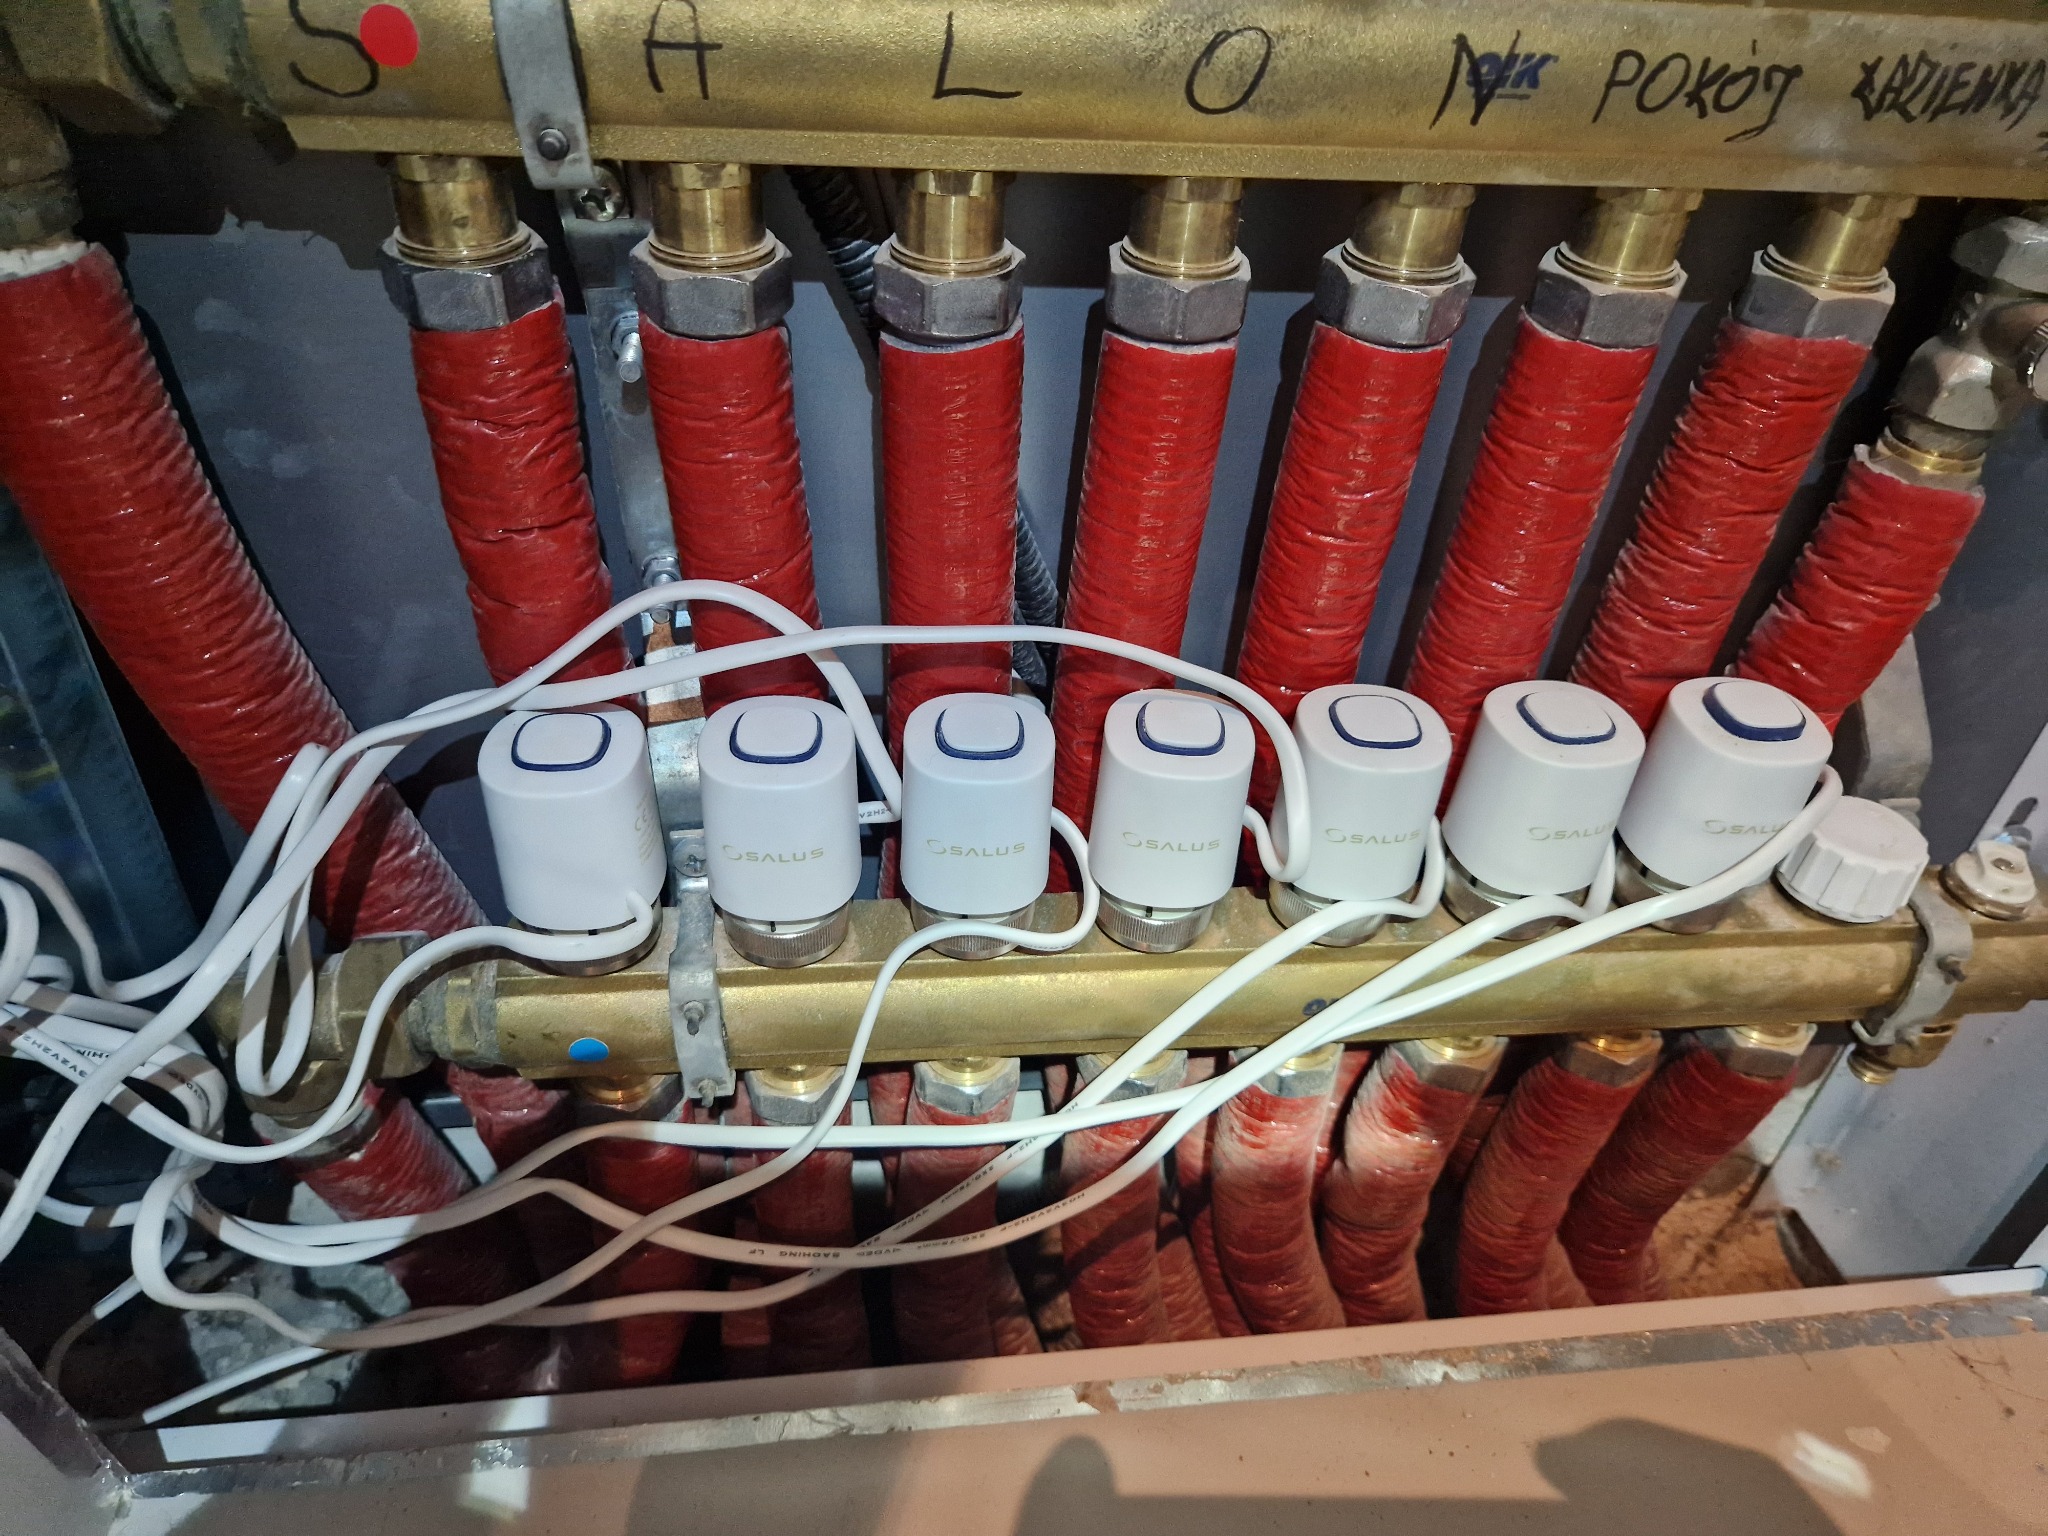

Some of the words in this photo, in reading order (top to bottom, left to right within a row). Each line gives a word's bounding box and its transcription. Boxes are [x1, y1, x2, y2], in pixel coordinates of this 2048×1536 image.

[1729, 821, 1784, 835] SALU
[1350, 829, 1421, 845] SALUS
[949, 842, 1025, 857] SALUS
[1145, 839, 1220, 852] SALUS
[745, 847, 824, 863] SALUS
